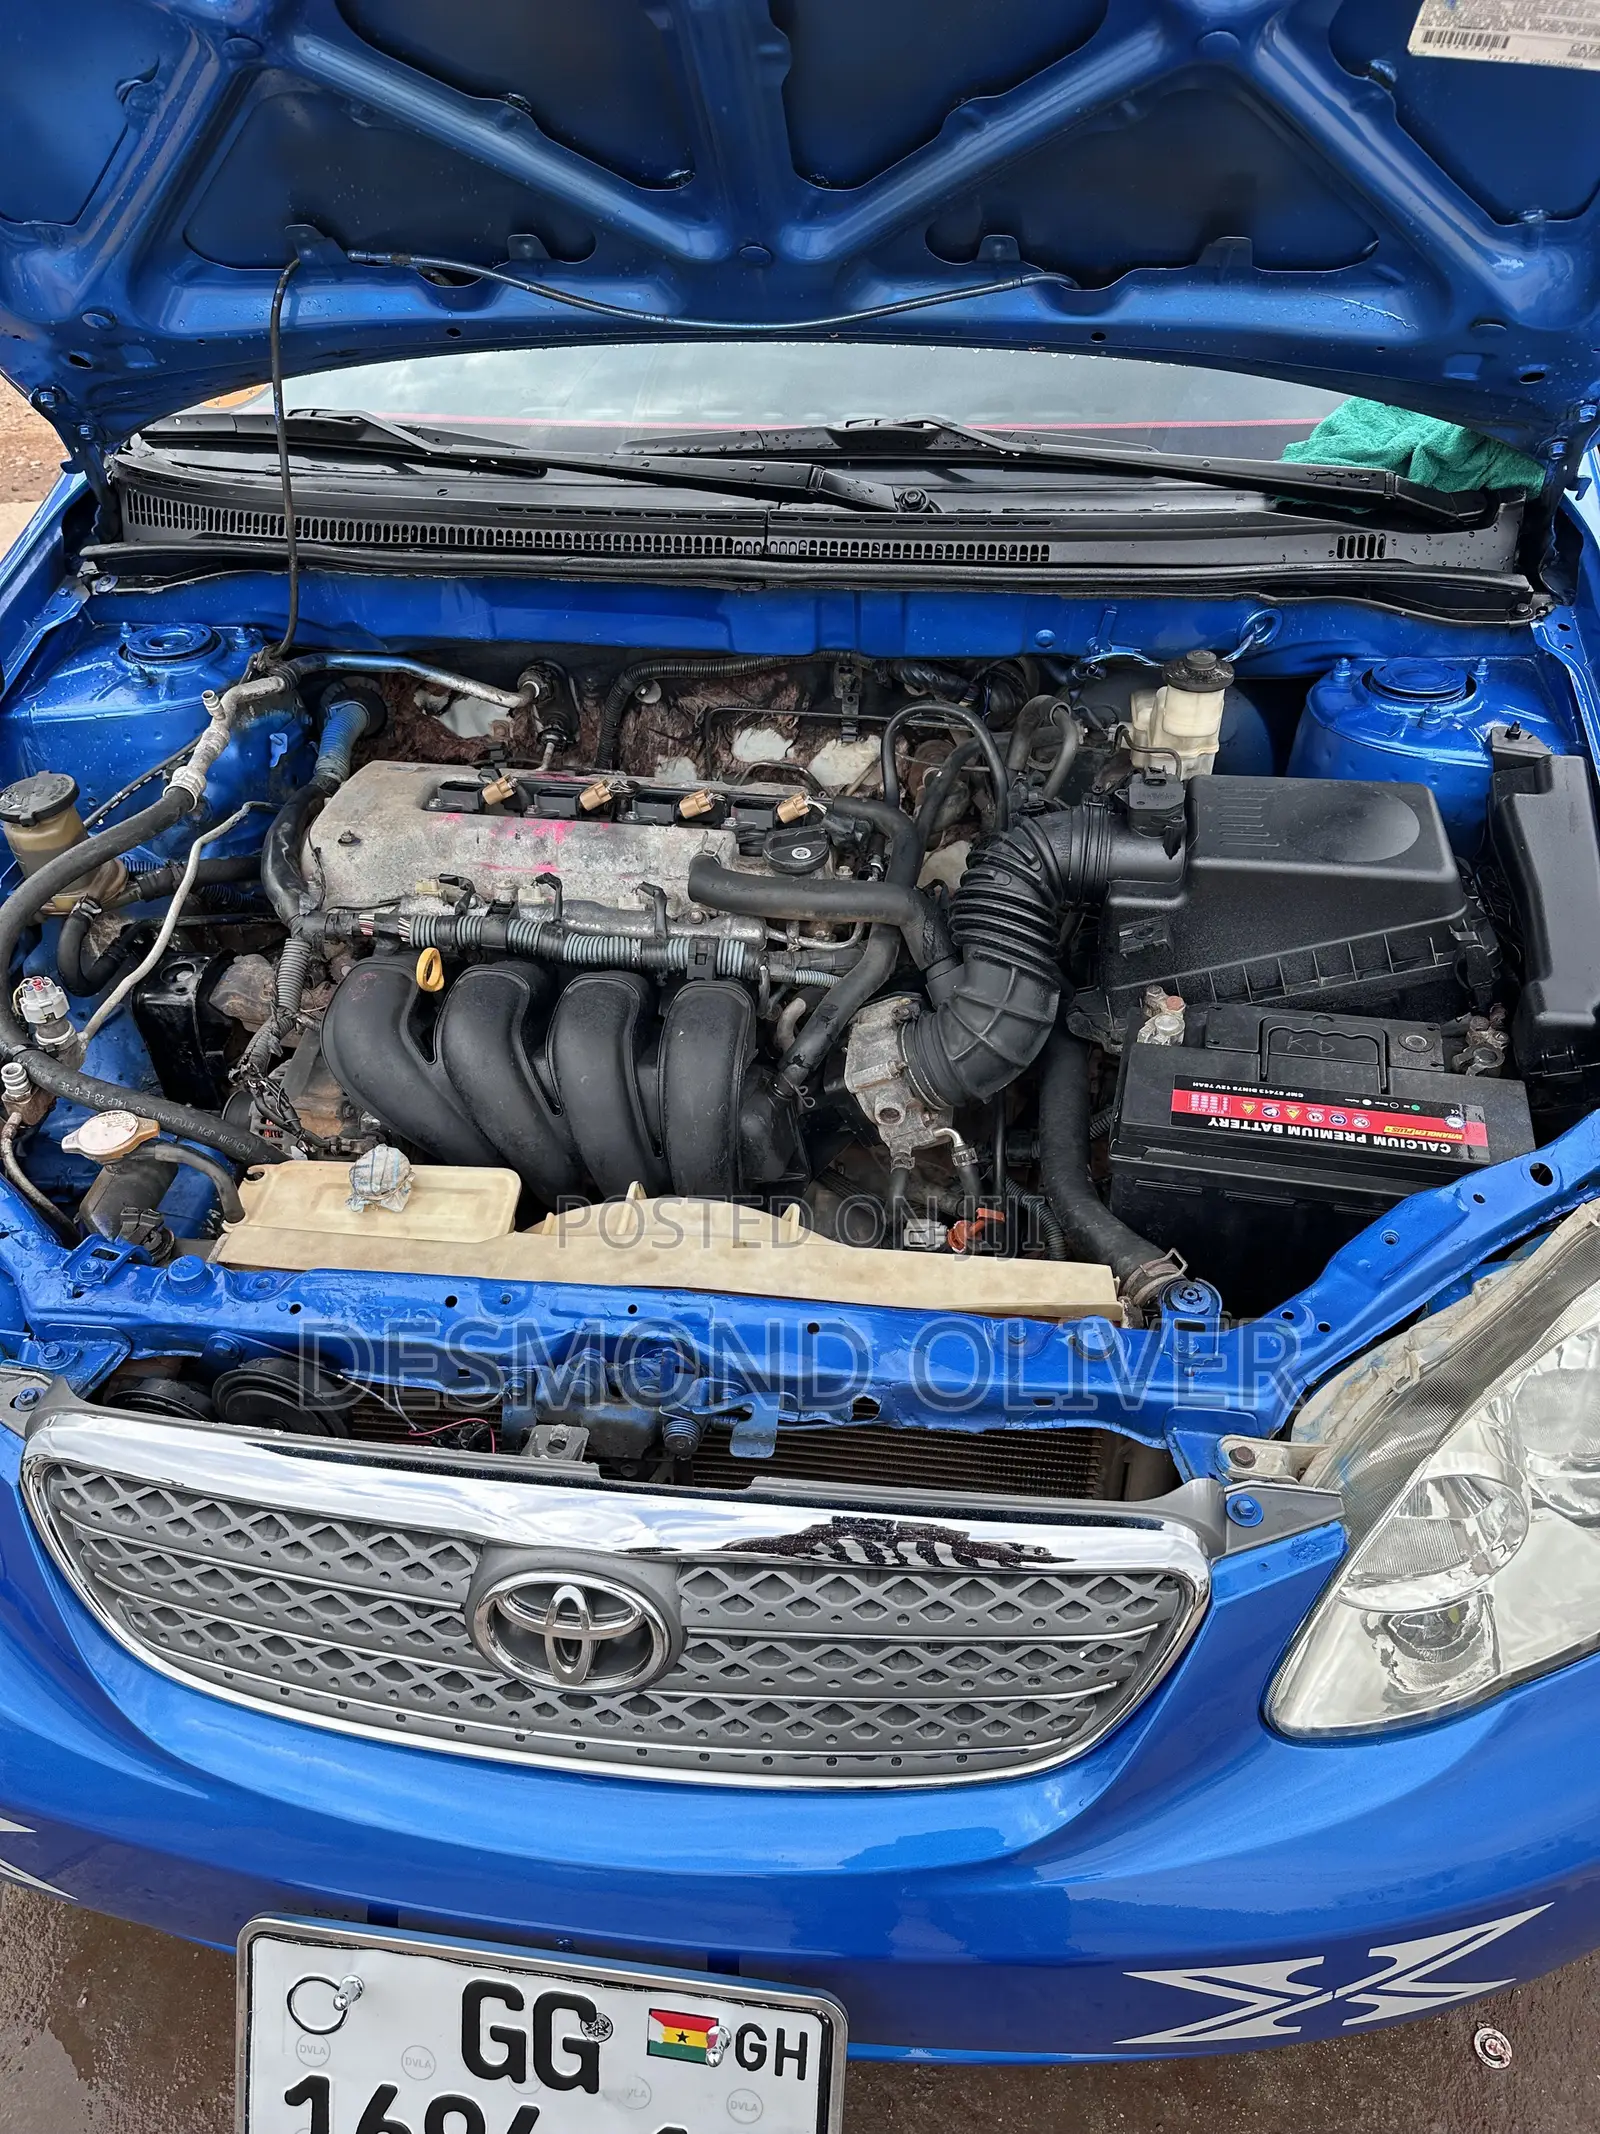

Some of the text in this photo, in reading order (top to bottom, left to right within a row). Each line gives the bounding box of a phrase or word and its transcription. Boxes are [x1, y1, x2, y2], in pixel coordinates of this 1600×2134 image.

[1208, 1117, 1451, 1153] CALCIUM PREMIUM BATTERY
[462, 1978, 600, 2094] GG
[299, 2044, 326, 2056] DVLA
[735, 2022, 808, 2080] GH
[404, 2056, 432, 2069] DVLA
[730, 2099, 758, 2112] DVLA
